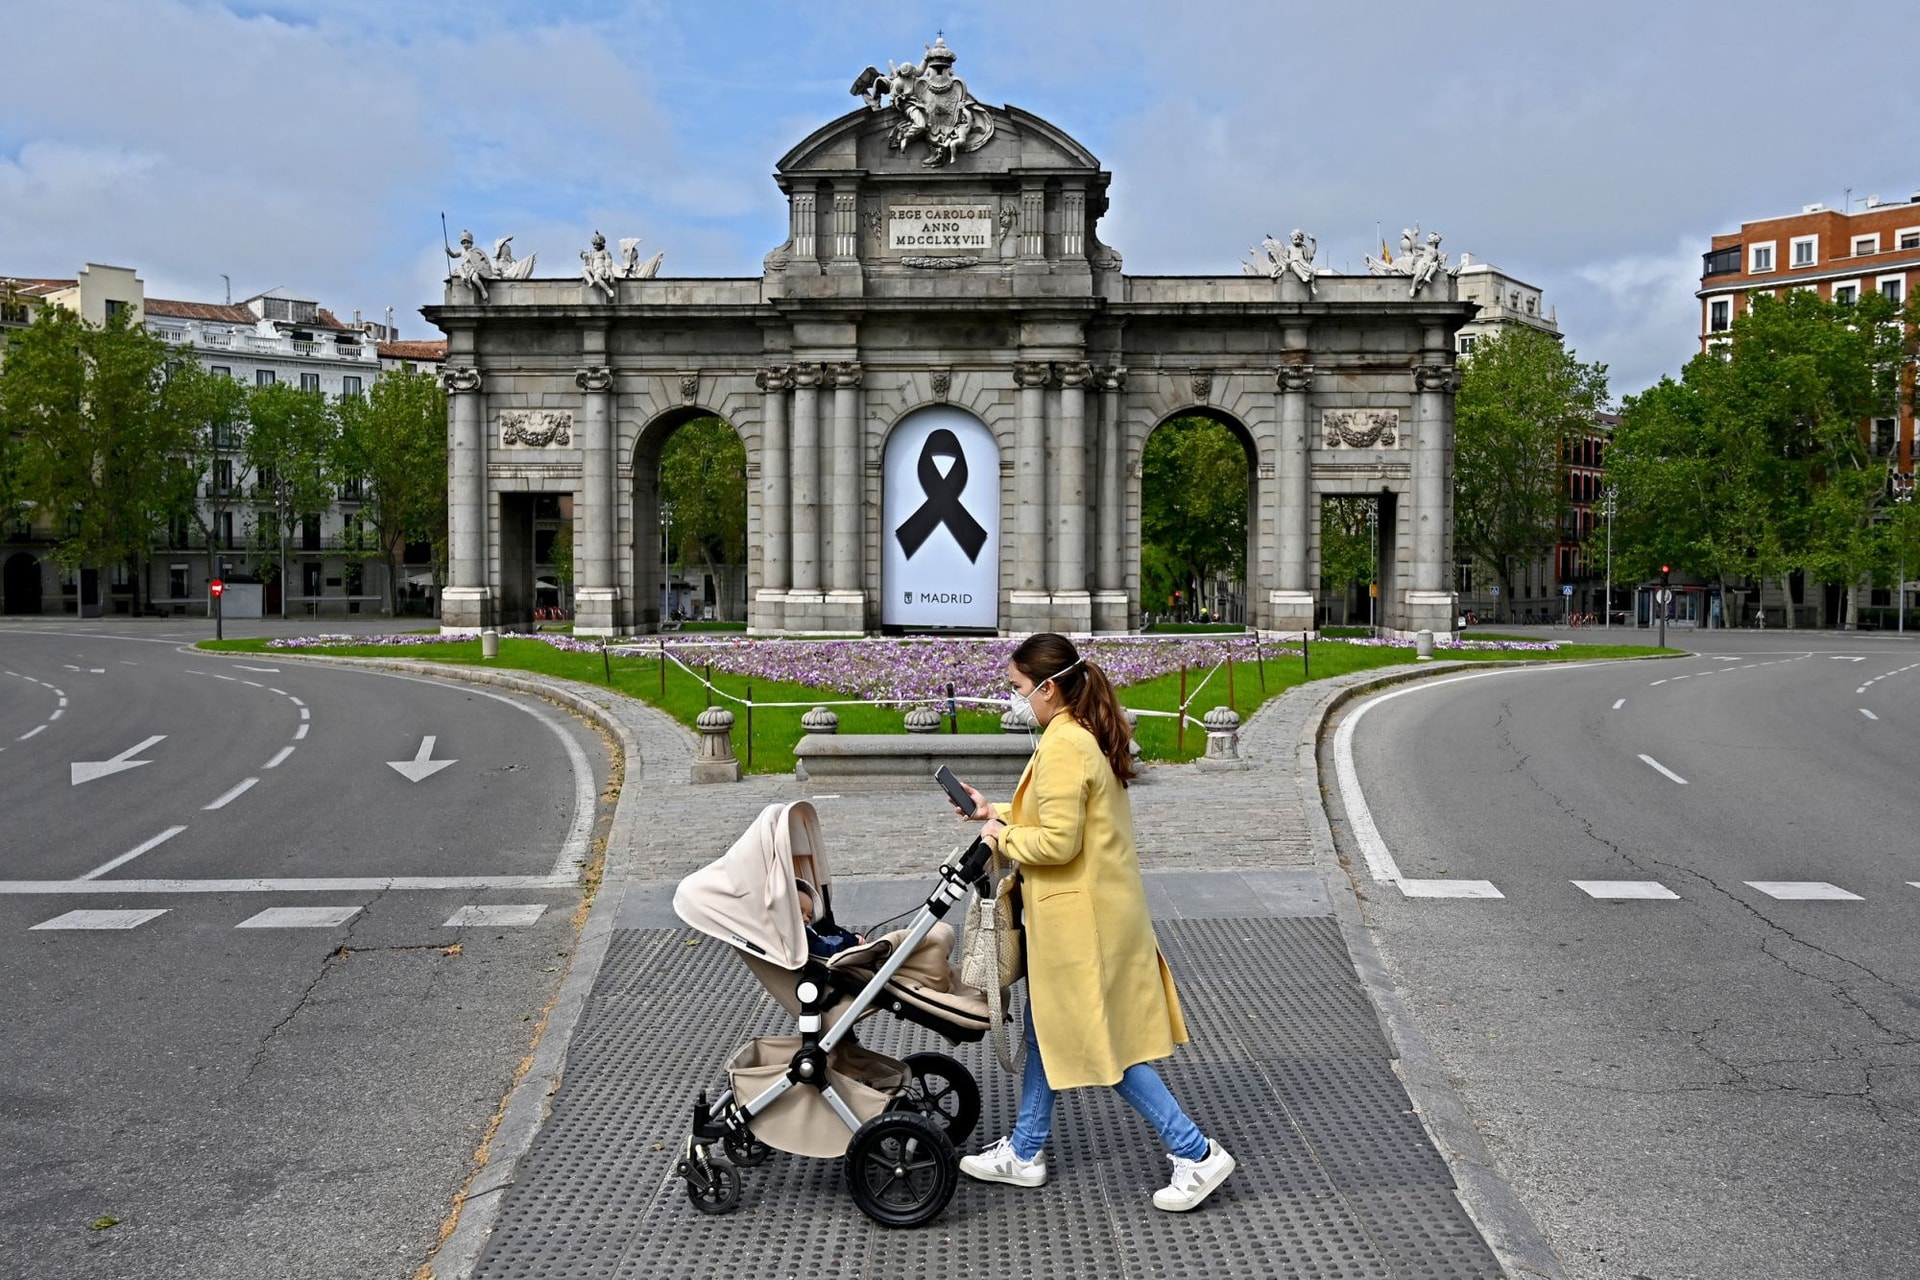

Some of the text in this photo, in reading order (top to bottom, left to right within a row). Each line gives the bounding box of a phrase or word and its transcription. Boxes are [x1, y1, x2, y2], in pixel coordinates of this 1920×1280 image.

[890, 210, 992, 219] REGE CAROLO III
[922, 223, 960, 232] ANNO
[896, 235, 985, 245] MDCCLXXVIII
[920, 593, 973, 604] MADRID
